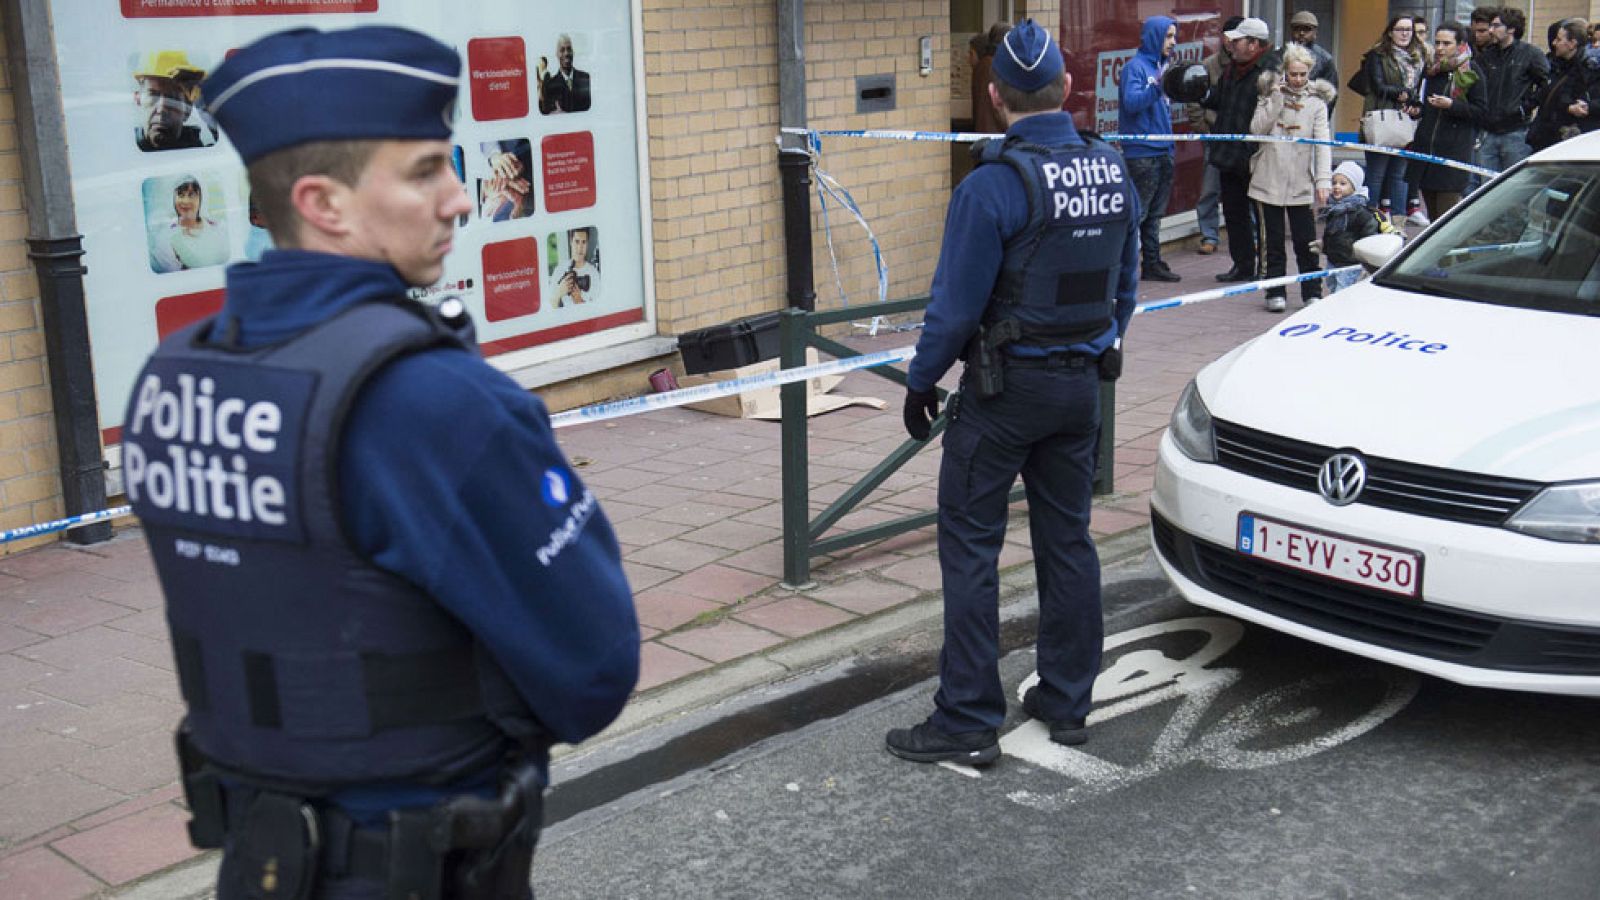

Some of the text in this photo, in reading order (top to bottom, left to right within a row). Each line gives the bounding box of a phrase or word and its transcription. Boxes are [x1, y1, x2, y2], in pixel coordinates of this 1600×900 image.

[1042, 157, 1124, 190] Politie
[1054, 188, 1124, 219] Police
[1322, 327, 1448, 354] Police
[131, 374, 282, 453] Police
[124, 441, 288, 526] Politie
